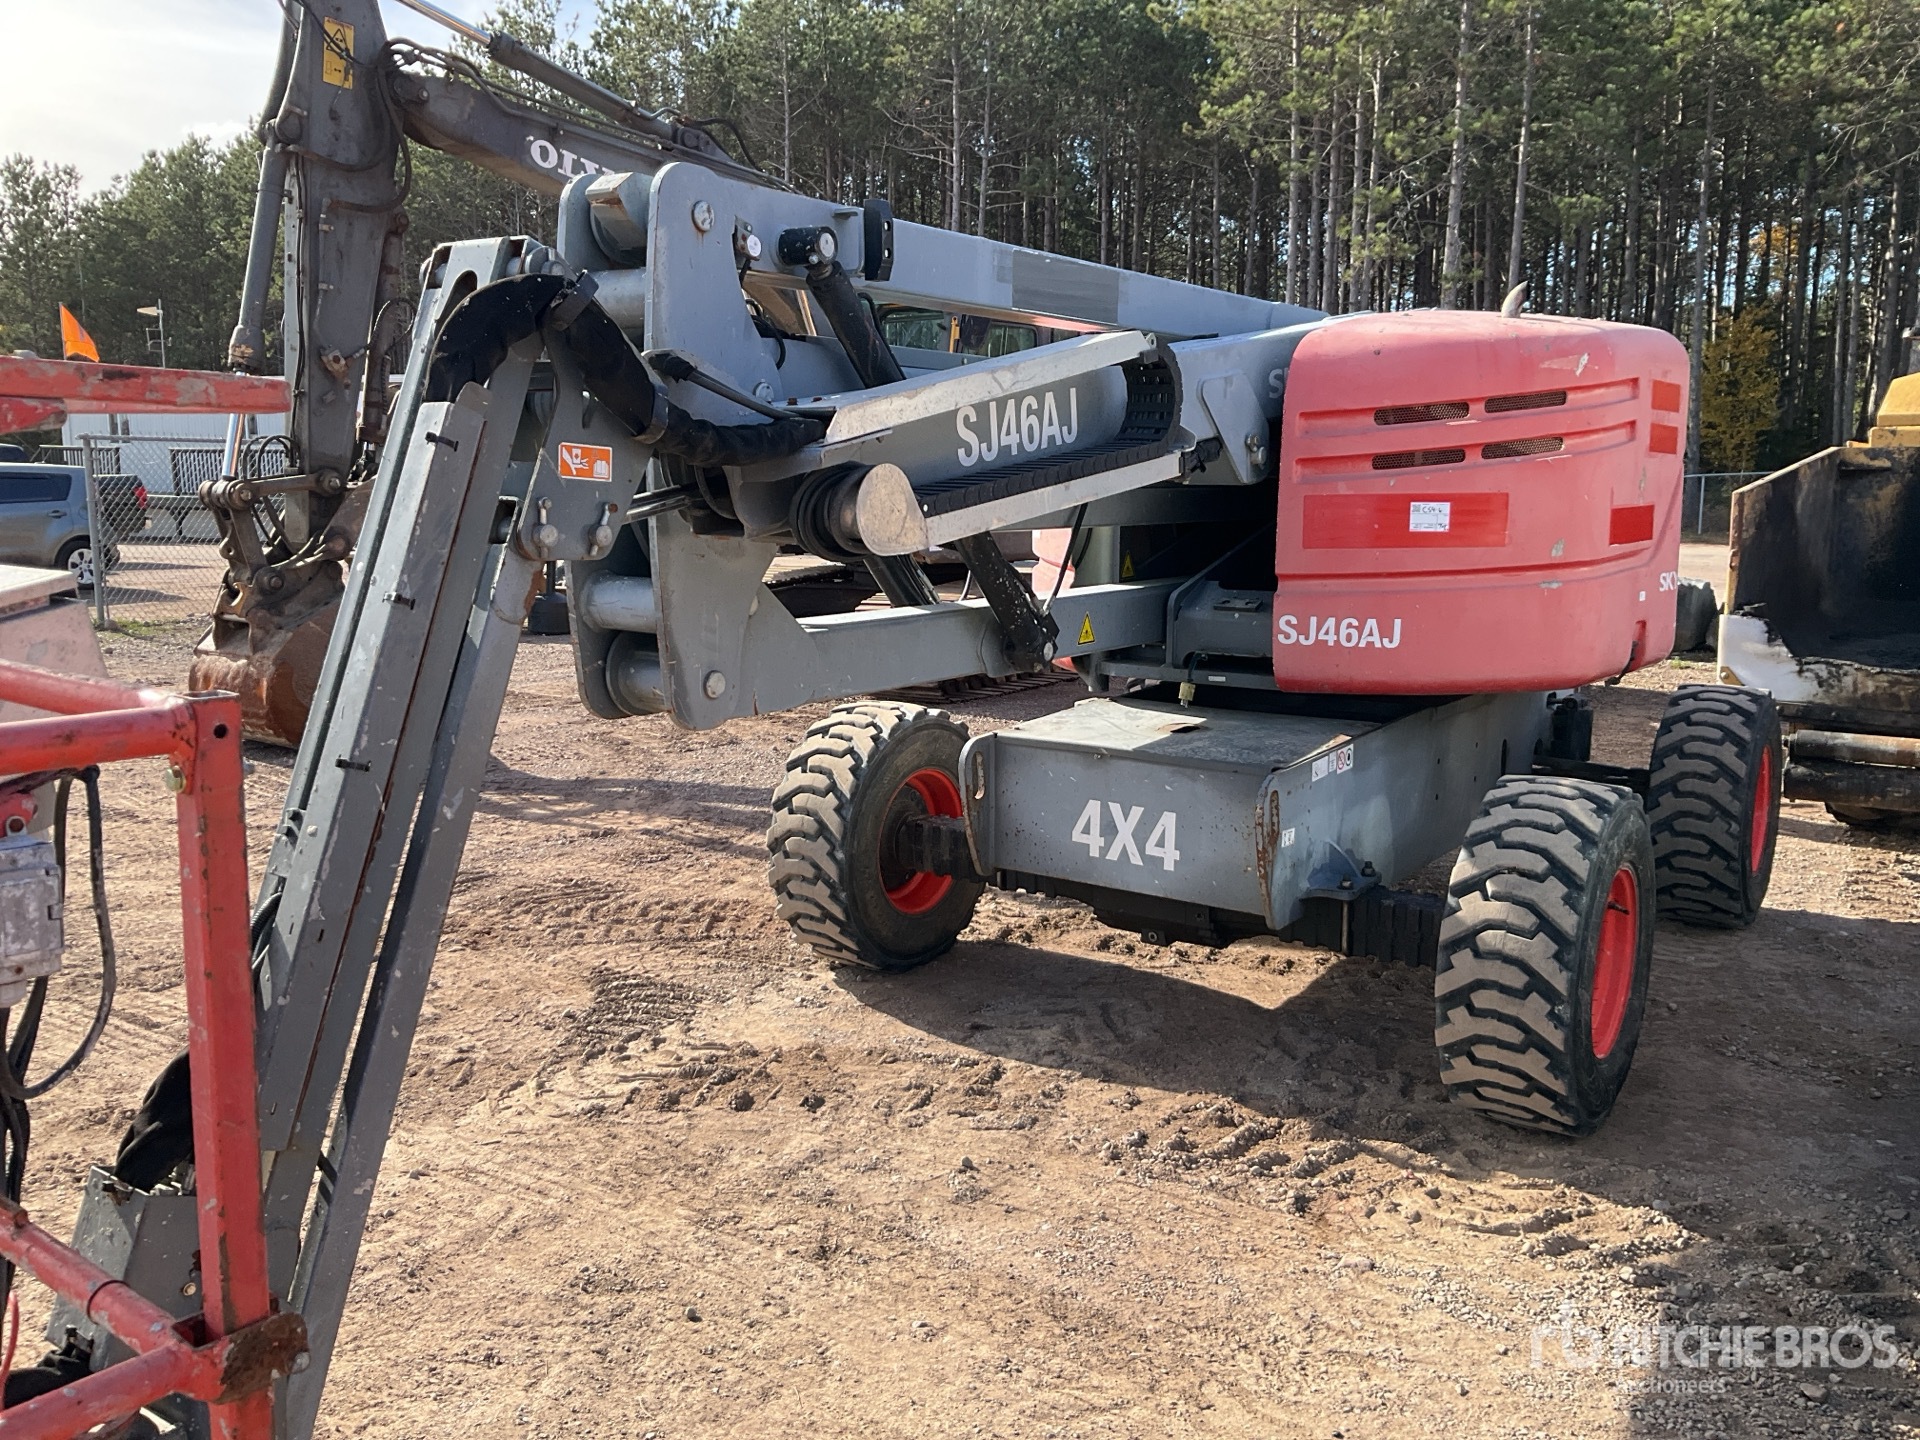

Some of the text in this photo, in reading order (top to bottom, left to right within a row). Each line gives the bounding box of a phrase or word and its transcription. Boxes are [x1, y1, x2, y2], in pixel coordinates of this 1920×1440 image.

[956, 387, 1078, 467] SJ46AJ
[1277, 614, 1402, 649] SJ46AJ
[1071, 799, 1180, 872] 4X4
